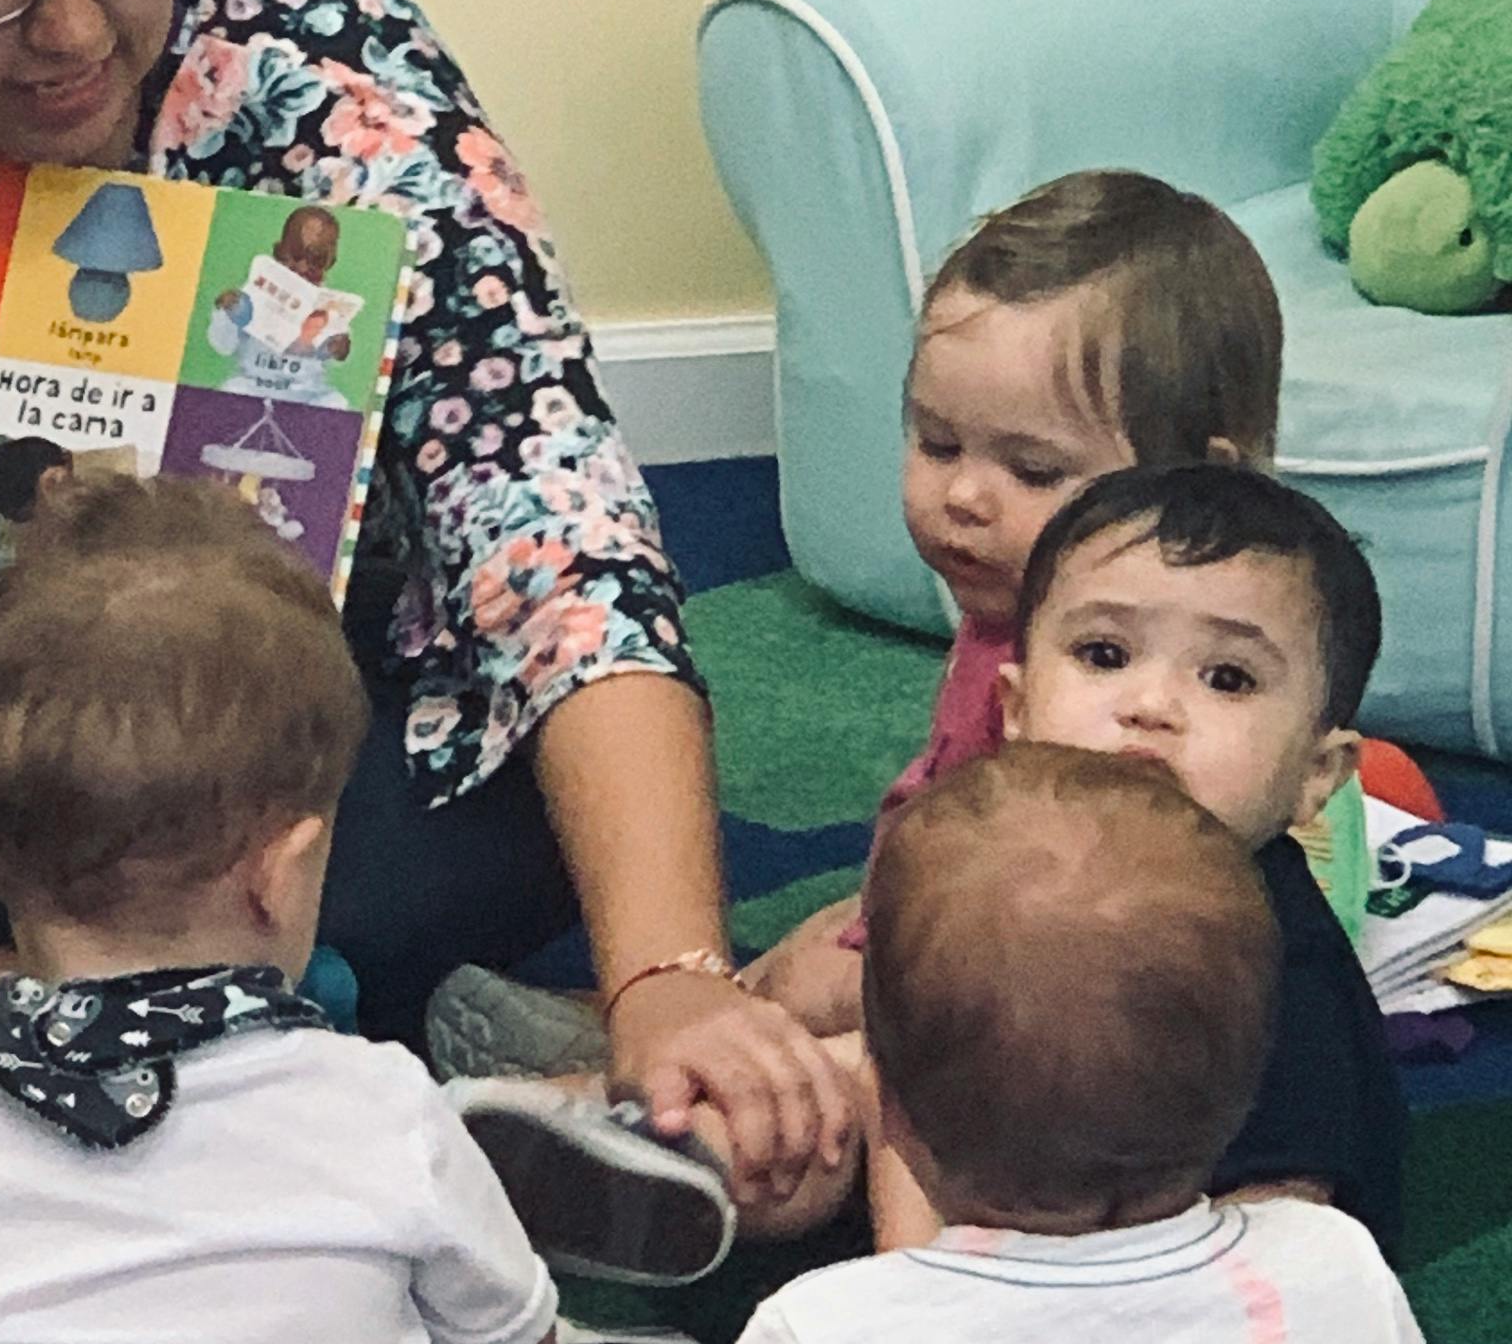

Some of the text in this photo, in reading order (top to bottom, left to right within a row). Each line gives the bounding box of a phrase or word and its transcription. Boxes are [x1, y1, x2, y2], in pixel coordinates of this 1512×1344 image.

[70, 377, 104, 405] de
[112, 382, 134, 409] ir
[142, 393, 156, 412] a
[18, 399, 124, 438] la cama
